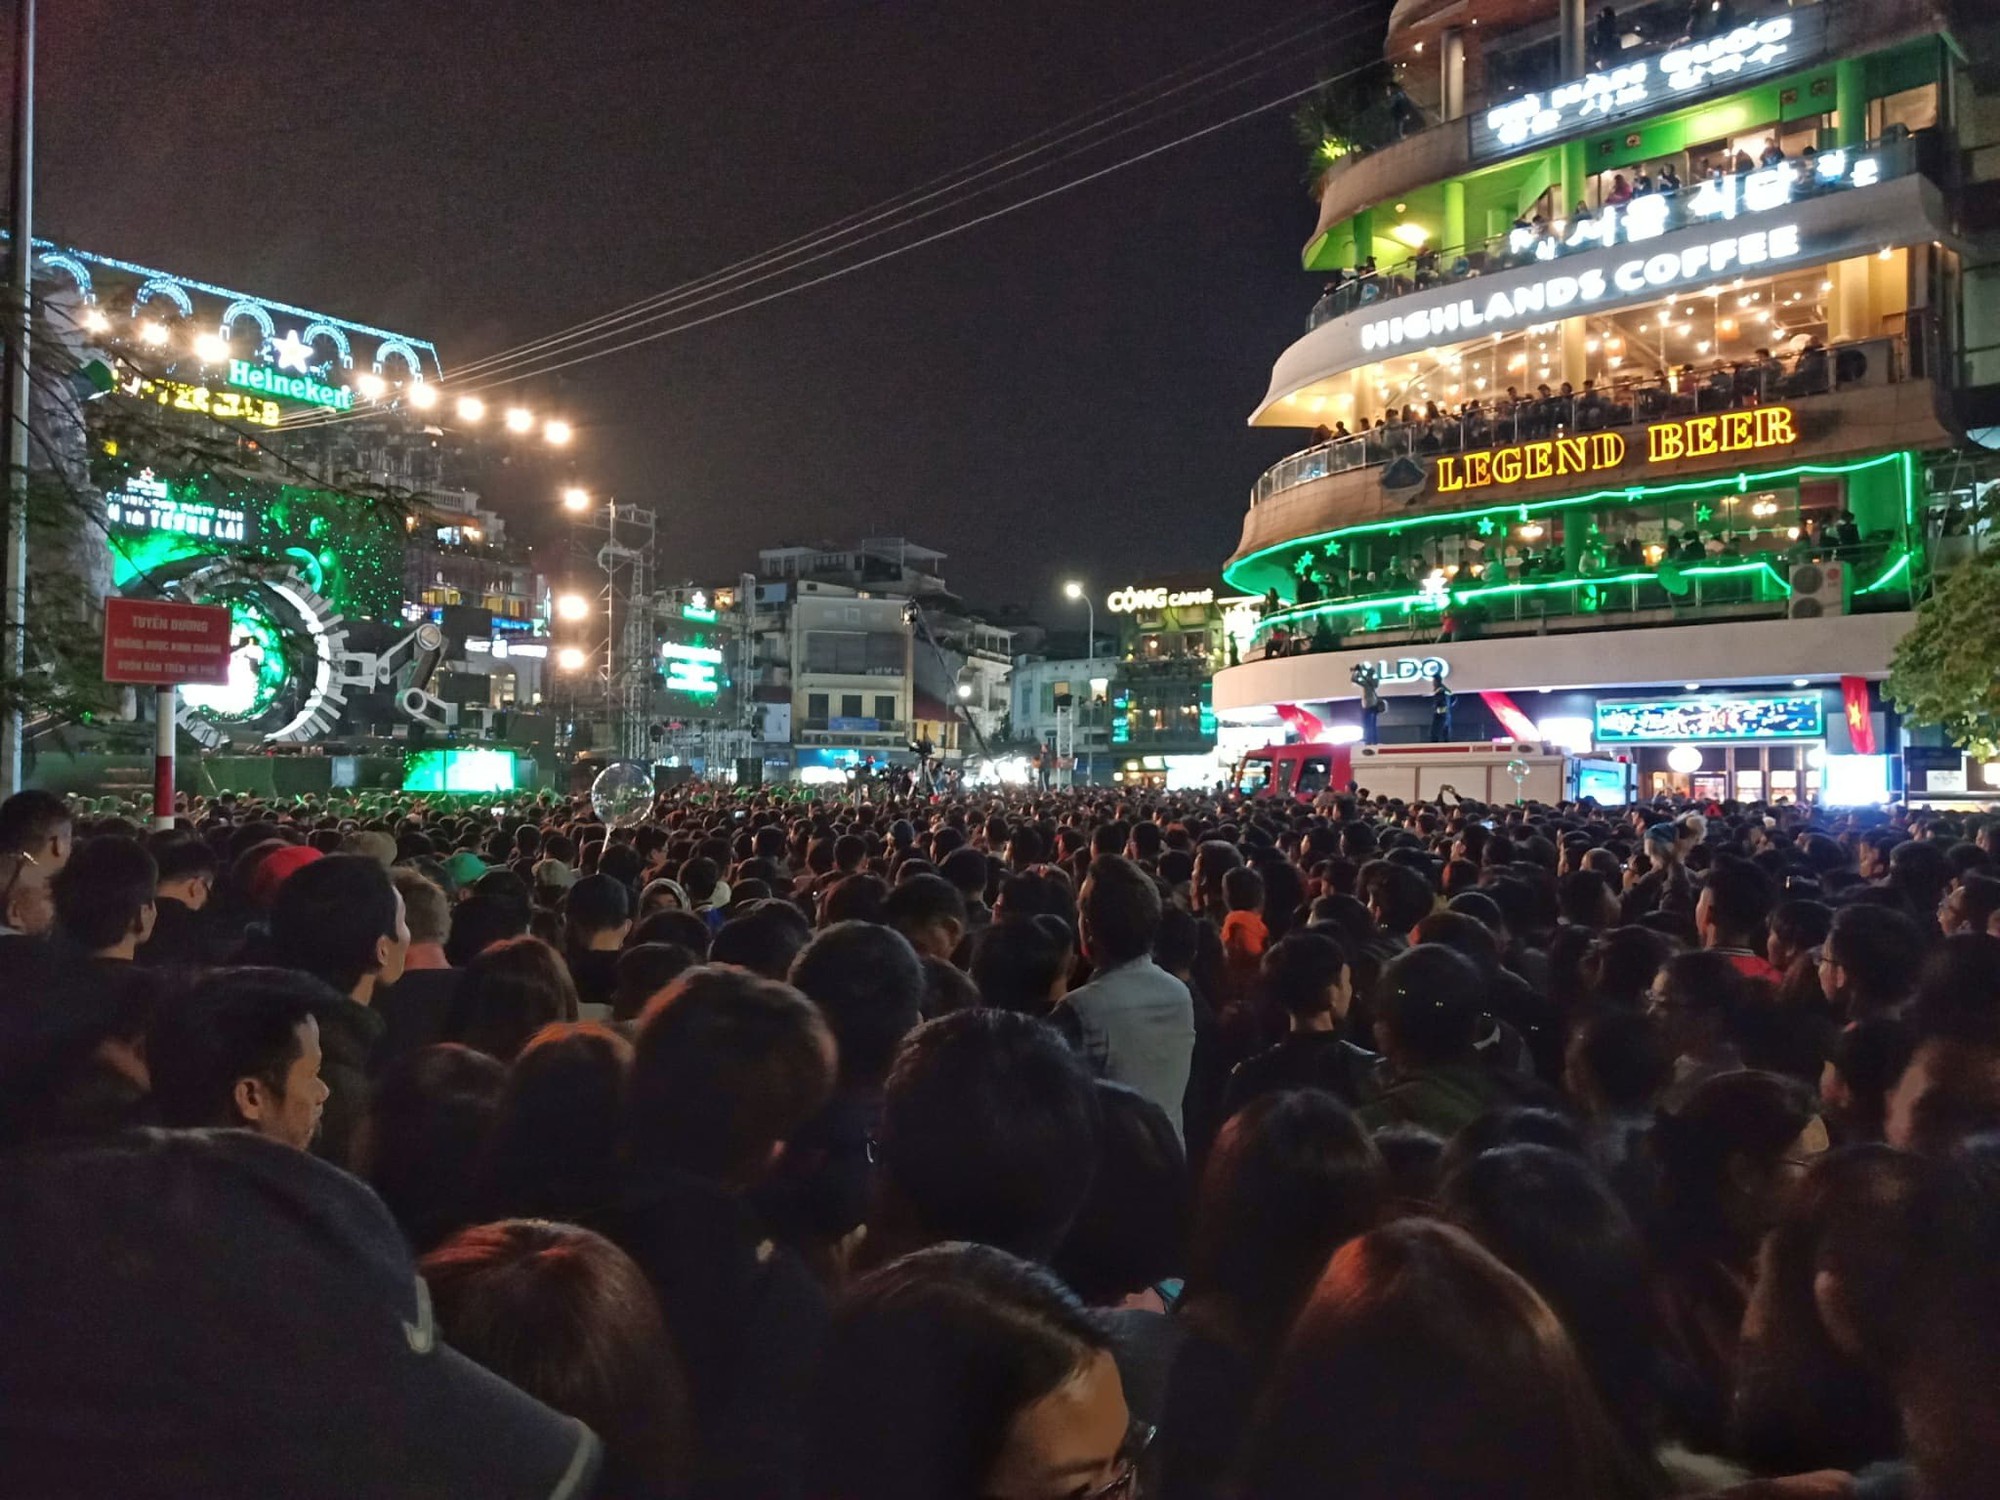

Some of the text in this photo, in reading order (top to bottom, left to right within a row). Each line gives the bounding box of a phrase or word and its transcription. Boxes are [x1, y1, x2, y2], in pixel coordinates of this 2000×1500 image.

[1361, 267, 1606, 351] HIGHLANDS
[1614, 224, 1800, 292] COFFEE
[228, 358, 352, 410] Heineken
[1436, 406, 1796, 493] LEGEND BEER
[1357, 656, 1450, 685] LDO
